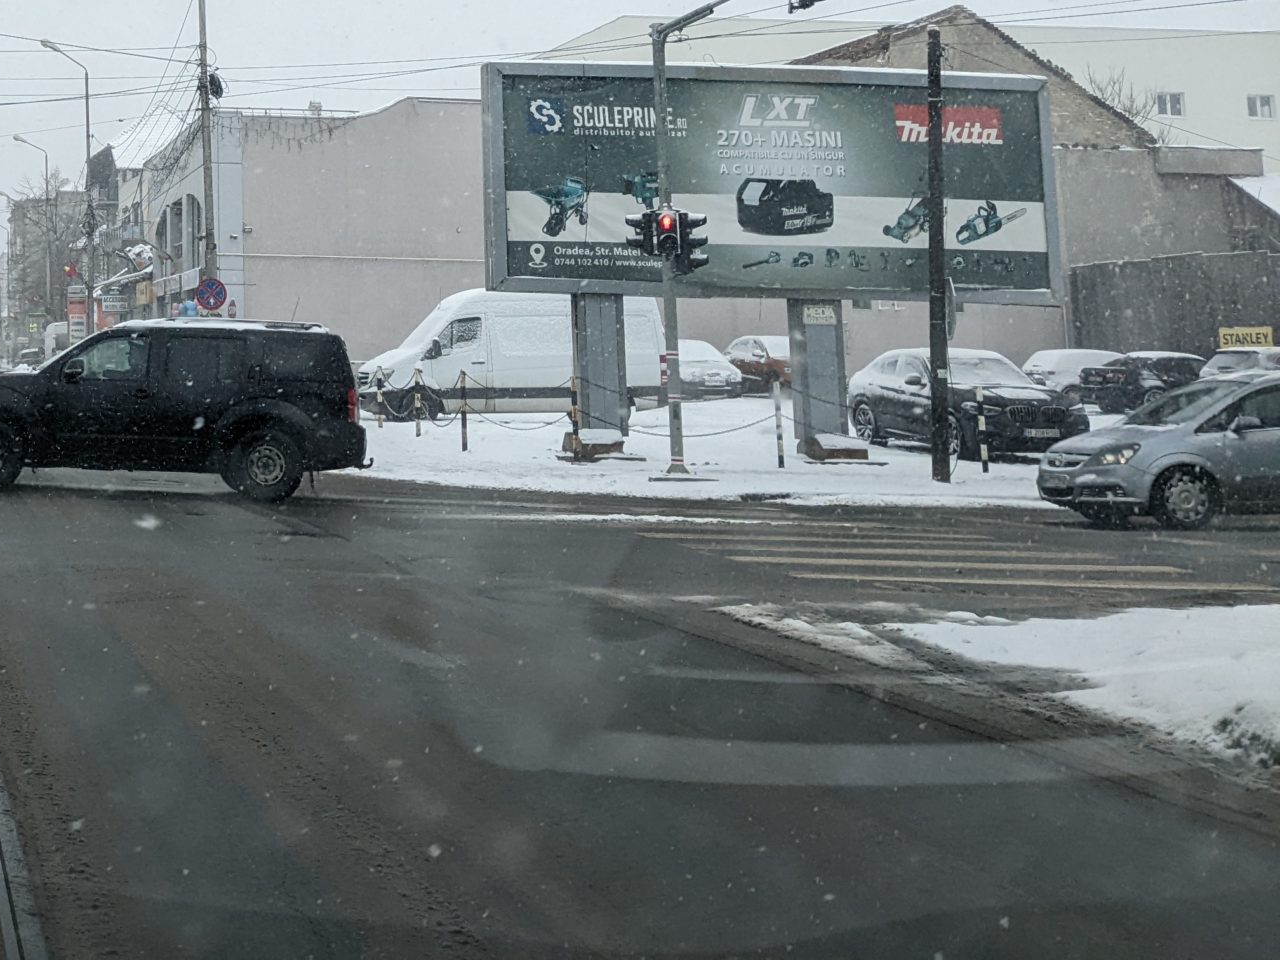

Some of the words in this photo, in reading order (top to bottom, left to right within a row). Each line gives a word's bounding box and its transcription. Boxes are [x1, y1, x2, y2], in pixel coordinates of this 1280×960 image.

[738, 94, 820, 128] LXT
[574, 128, 635, 137] distribuitor
[639, 129, 688, 138] autizat
[716, 130, 767, 147] 270+
[717, 149, 778, 160] COMPATIBILE
[810, 151, 846, 161] SINGUR
[719, 163, 847, 177] ACUMULATOR
[553, 246, 593, 256] Oradea,
[595, 246, 612, 256] Str.
[554, 258, 575, 267] 0744
[1222, 331, 1270, 346] STANLEY
